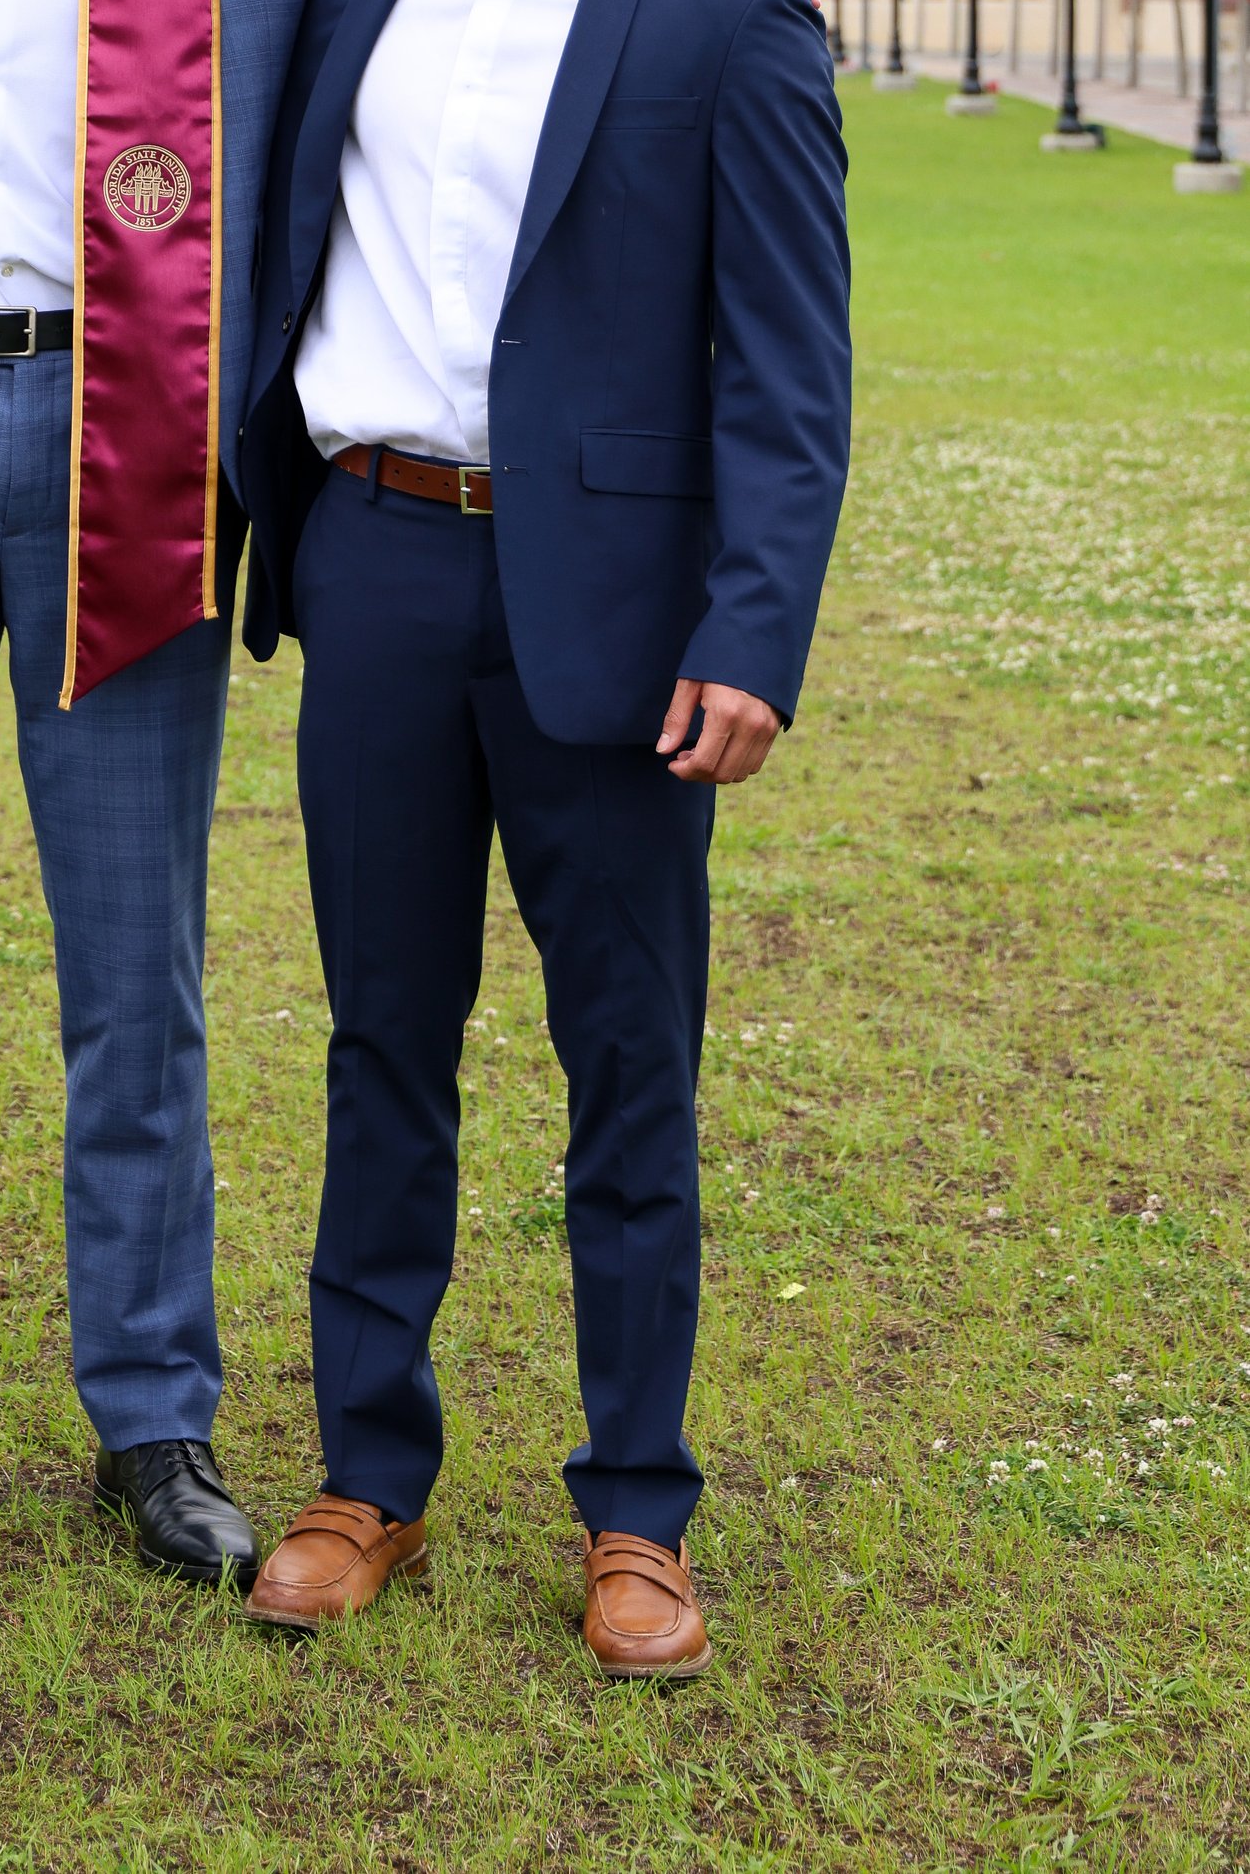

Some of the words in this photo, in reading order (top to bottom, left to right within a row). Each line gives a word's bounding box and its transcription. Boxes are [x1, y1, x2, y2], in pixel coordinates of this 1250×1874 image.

[109, 162, 126, 209] FLORIDA
[125, 150, 157, 164] STATE
[159, 153, 186, 213] UNIVERSITY
[135, 217, 157, 227] 1851
